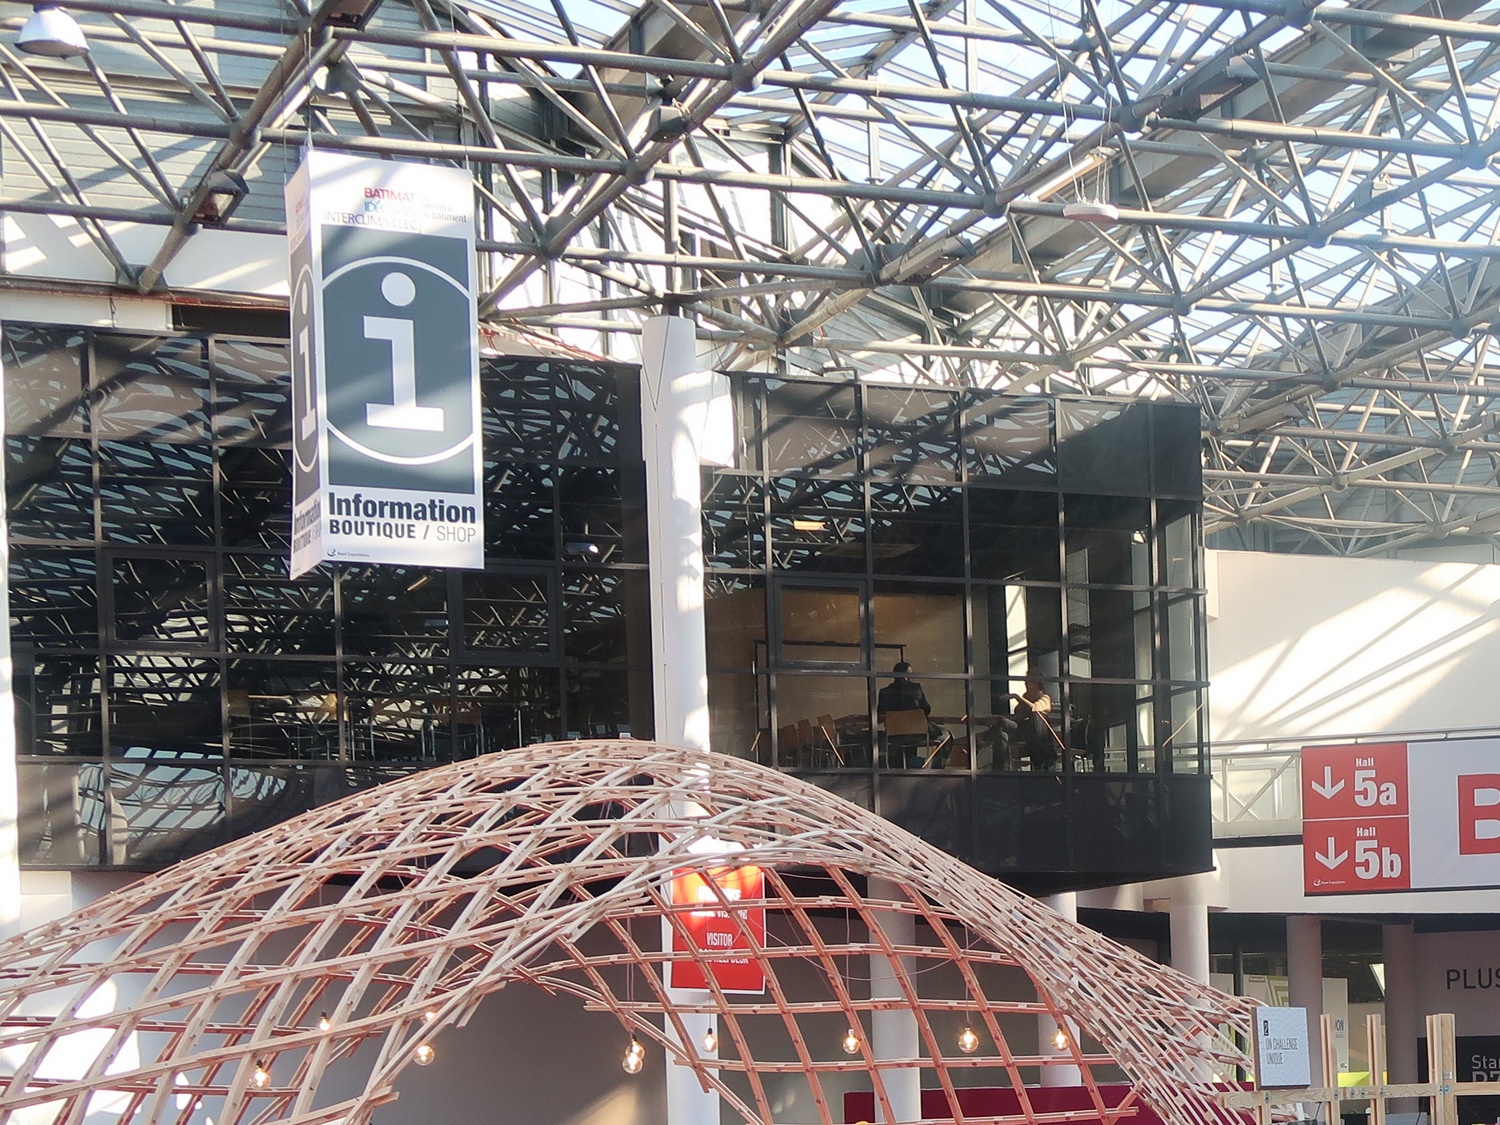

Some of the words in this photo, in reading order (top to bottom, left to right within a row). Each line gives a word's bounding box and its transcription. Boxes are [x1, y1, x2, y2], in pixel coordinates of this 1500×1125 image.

[329, 492, 476, 524] Information
[329, 519, 416, 539] BOUTIQUE
[436, 525, 476, 543] SHOP
[1356, 758, 1374, 767] Hall
[1354, 769, 1397, 807] 5a
[1356, 827, 1376, 837] Hall
[1355, 839, 1402, 880] 5b
[706, 932, 733, 946] VISITOR
[1265, 1038, 1273, 1050] UN
[1273, 1038, 1298, 1050] CHALLENGE
[1266, 1052, 1283, 1065] UNIQUE
